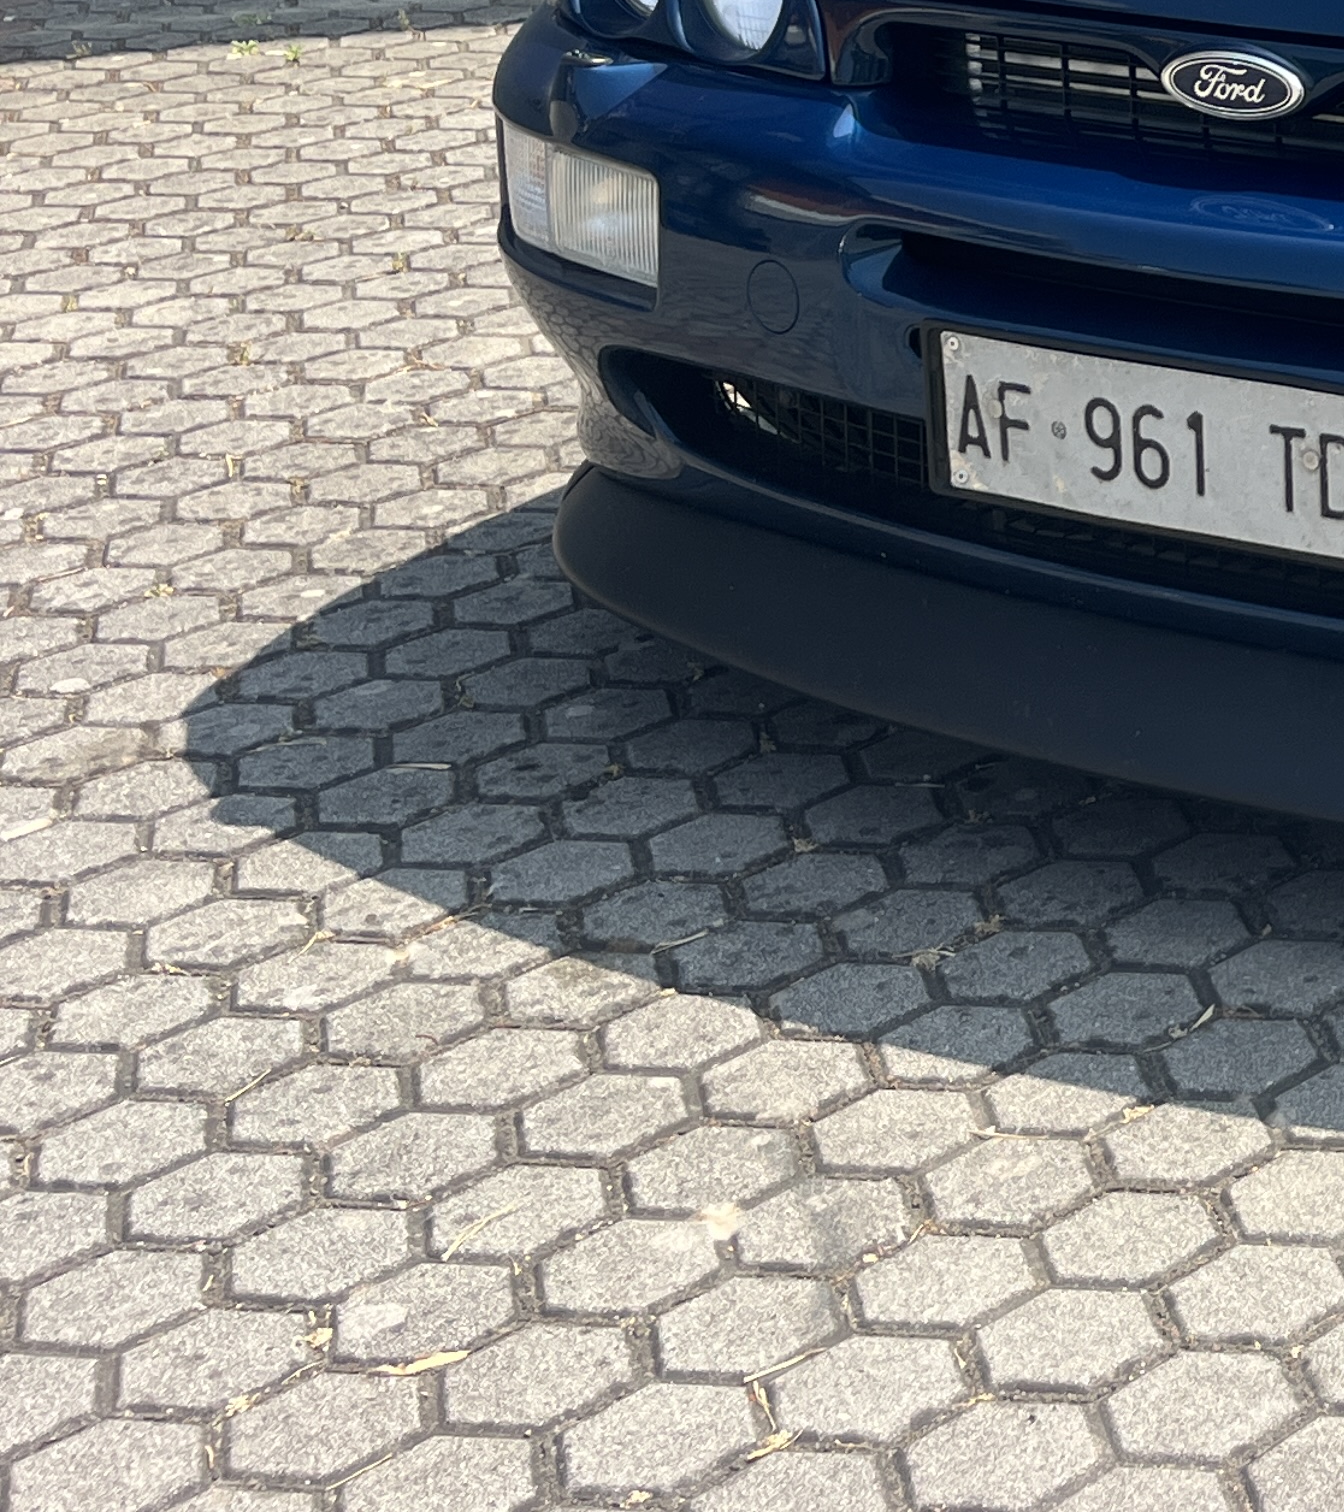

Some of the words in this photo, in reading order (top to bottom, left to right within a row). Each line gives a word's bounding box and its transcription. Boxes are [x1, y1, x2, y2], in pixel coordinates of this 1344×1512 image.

[1193, 63, 1267, 104] Ford
[957, 373, 1032, 463] AF
[1084, 396, 1206, 498] 961
